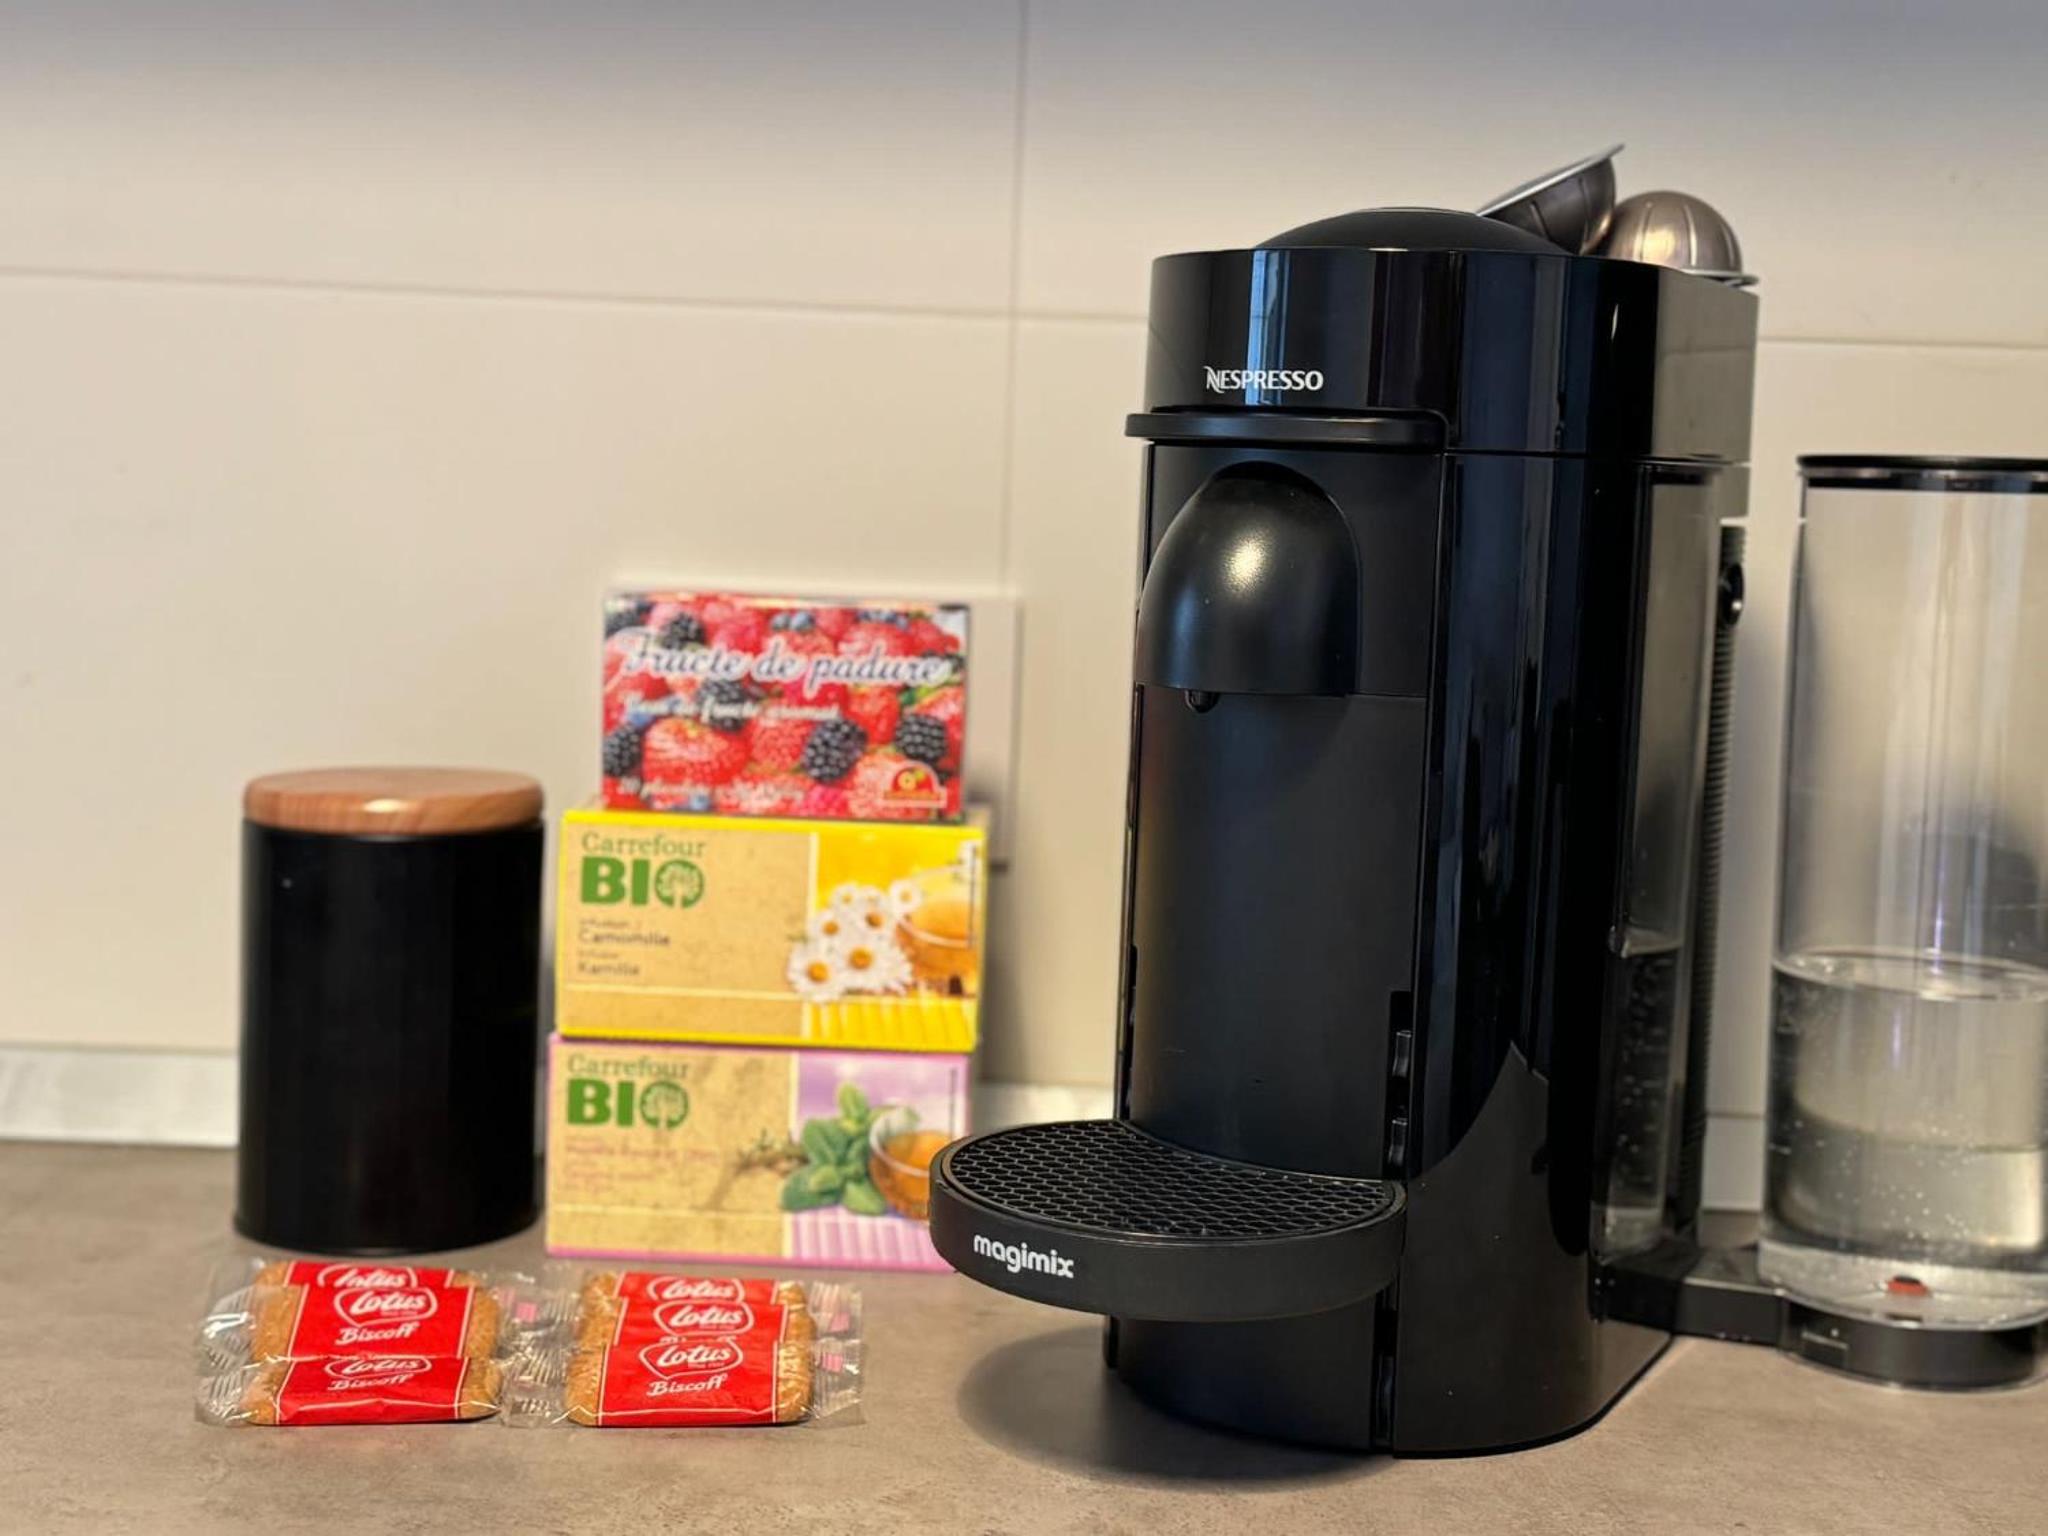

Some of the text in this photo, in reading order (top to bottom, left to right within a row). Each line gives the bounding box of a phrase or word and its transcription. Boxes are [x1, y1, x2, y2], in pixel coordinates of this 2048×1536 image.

[1203, 366, 1324, 394] NESPRESSO
[755, 640, 800, 678] de
[581, 831, 706, 857] Carrefour
[580, 856, 705, 909] BIO
[567, 1053, 689, 1078] Carrefour
[567, 1078, 689, 1130] BIO
[973, 1234, 1074, 1278] magimix
[350, 1291, 427, 1315] Lotus
[669, 1304, 743, 1327] Lotus
[334, 1321, 420, 1345] Biscoff
[657, 1345, 732, 1367] Lotus
[646, 1372, 729, 1396] Biscoff
